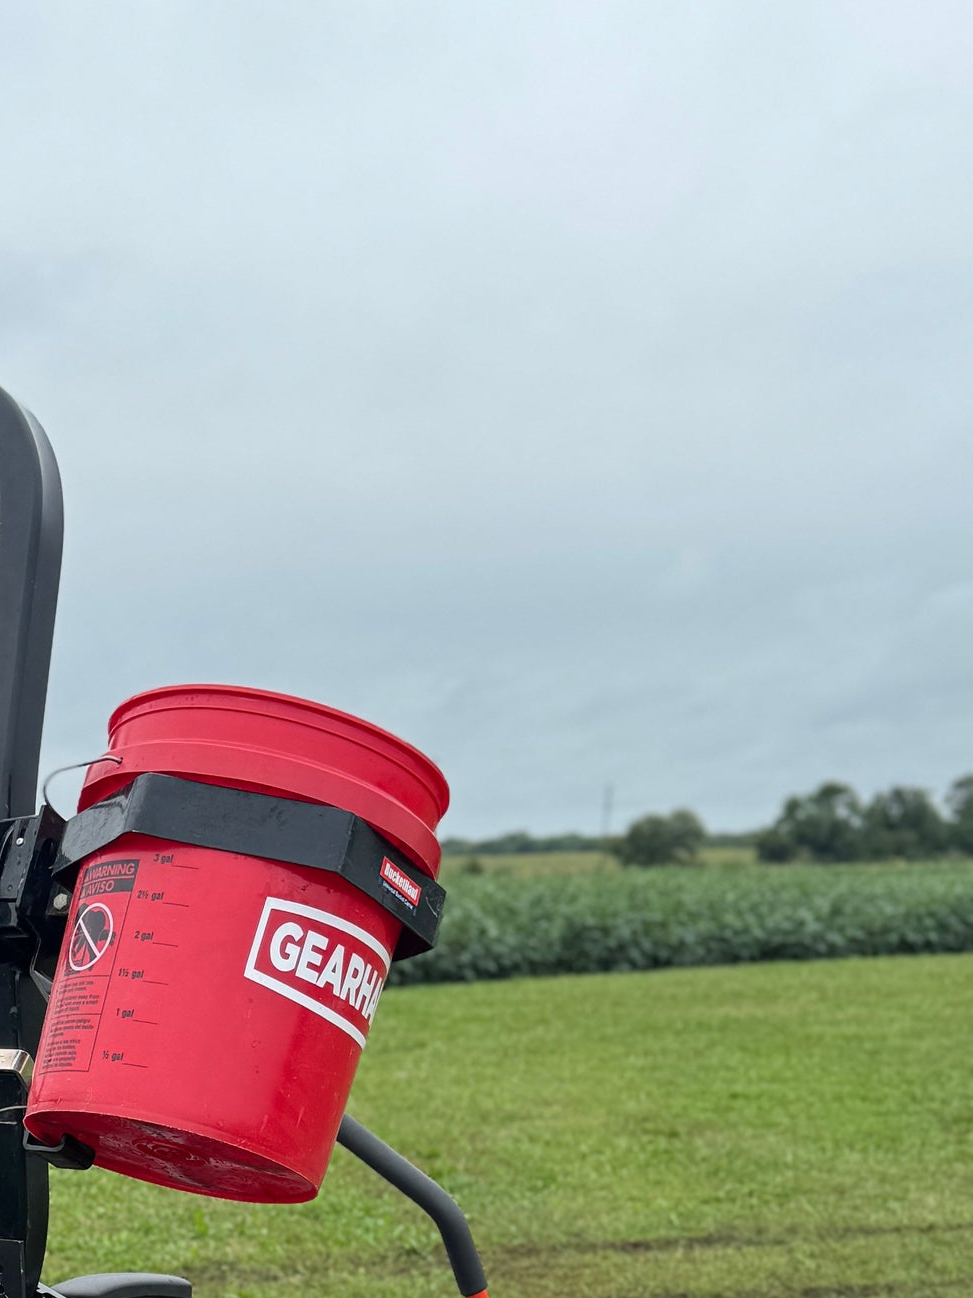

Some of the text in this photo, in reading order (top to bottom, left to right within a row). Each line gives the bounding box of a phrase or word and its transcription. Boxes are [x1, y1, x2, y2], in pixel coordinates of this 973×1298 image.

[153, 854, 174, 864] 3 gal
[89, 863, 135, 880] WARNING
[87, 880, 115, 896] AVISO
[151, 892, 164, 901] gal
[134, 931, 154, 941] 2 gal
[131, 970, 144, 980] gal
[121, 1009, 134, 1018] gal
[112, 1052, 124, 1061] gal
